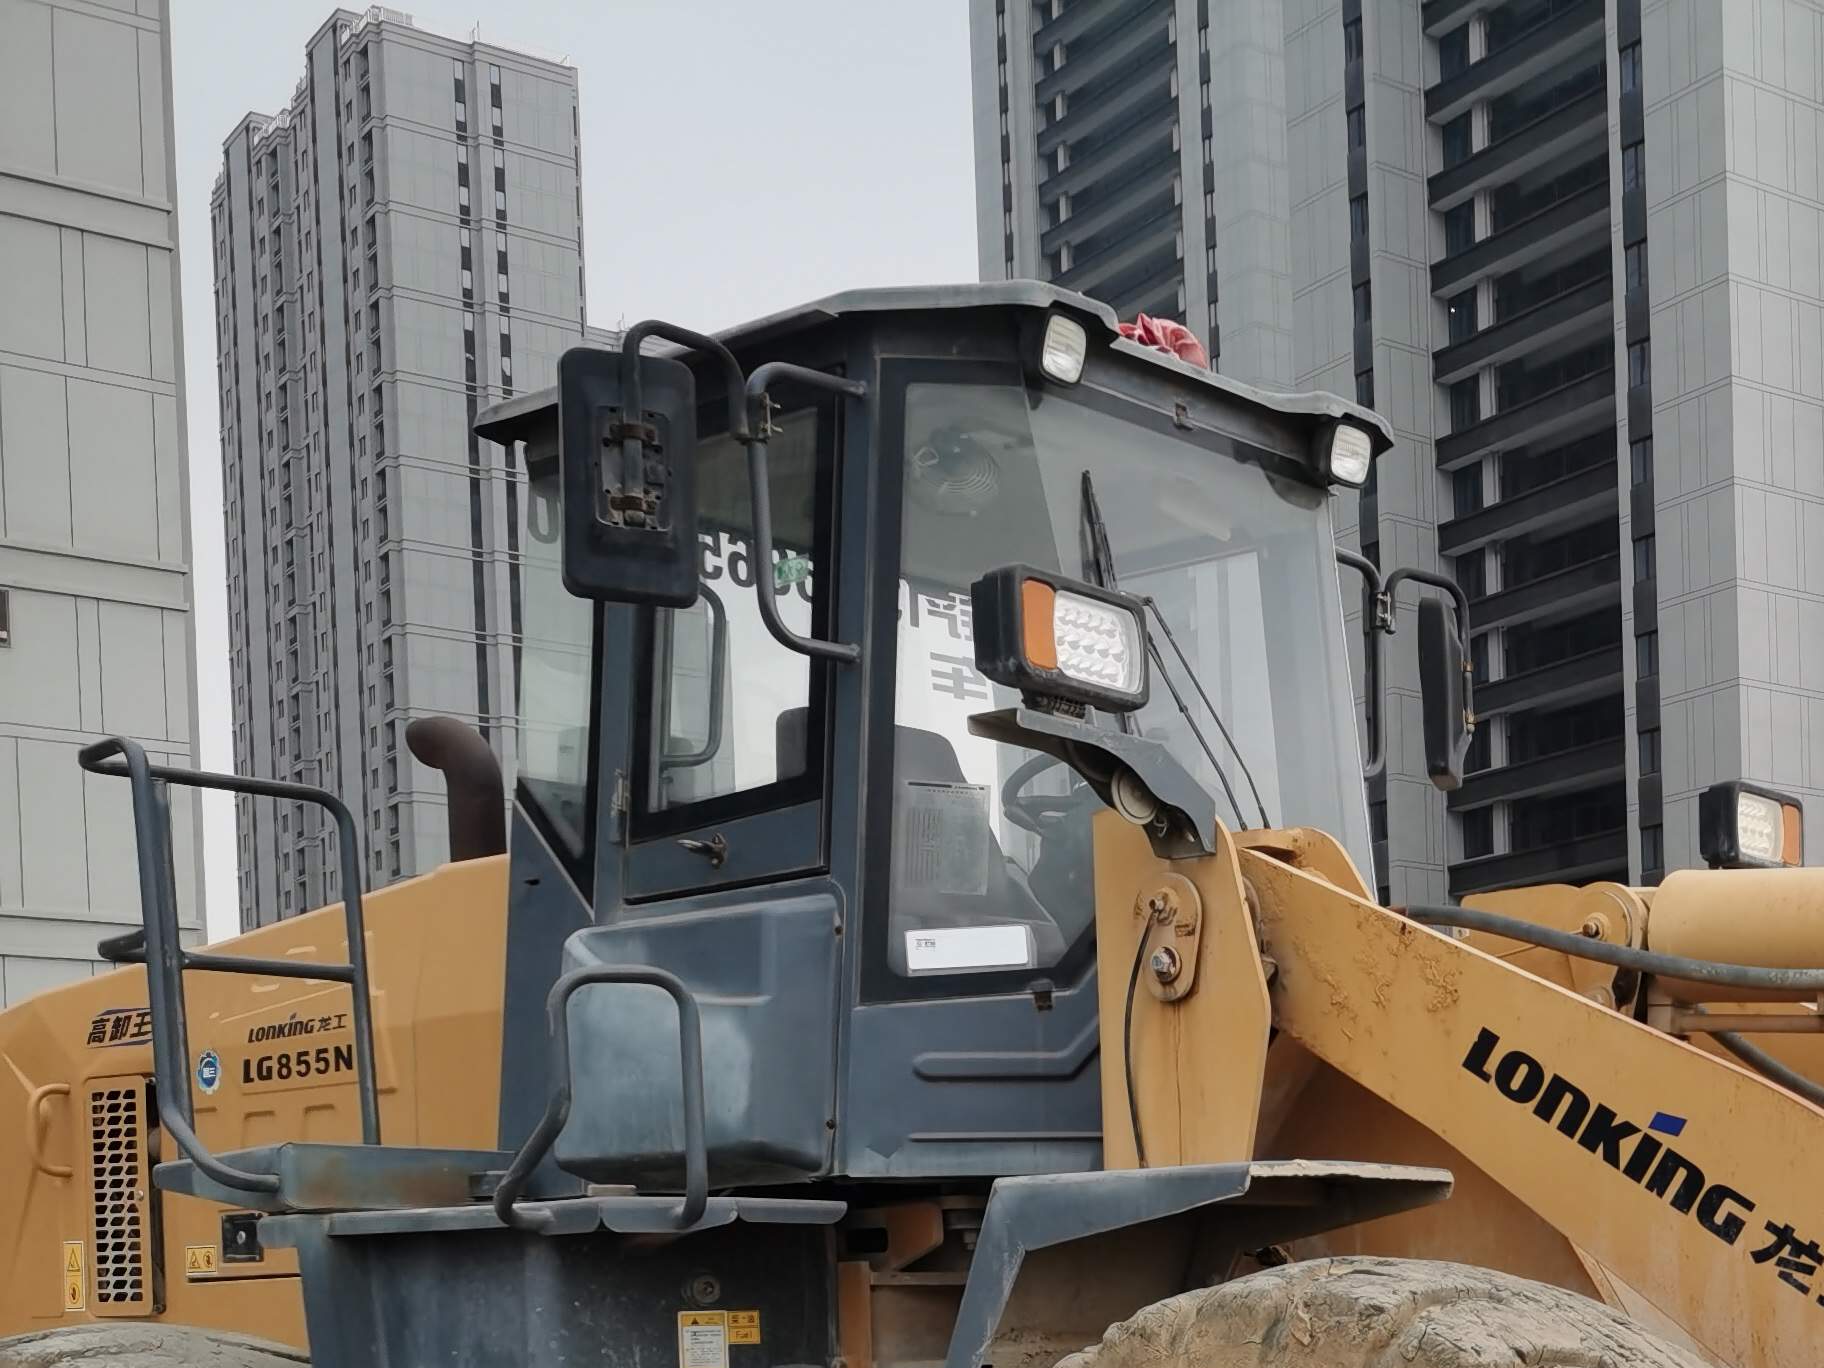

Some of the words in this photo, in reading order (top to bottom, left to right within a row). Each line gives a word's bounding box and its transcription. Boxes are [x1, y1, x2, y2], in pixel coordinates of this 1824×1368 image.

[87, 1010, 152, 1045] 高卸王
[316, 1013, 348, 1033] 龙工
[242, 1044, 354, 1084] LG855N
